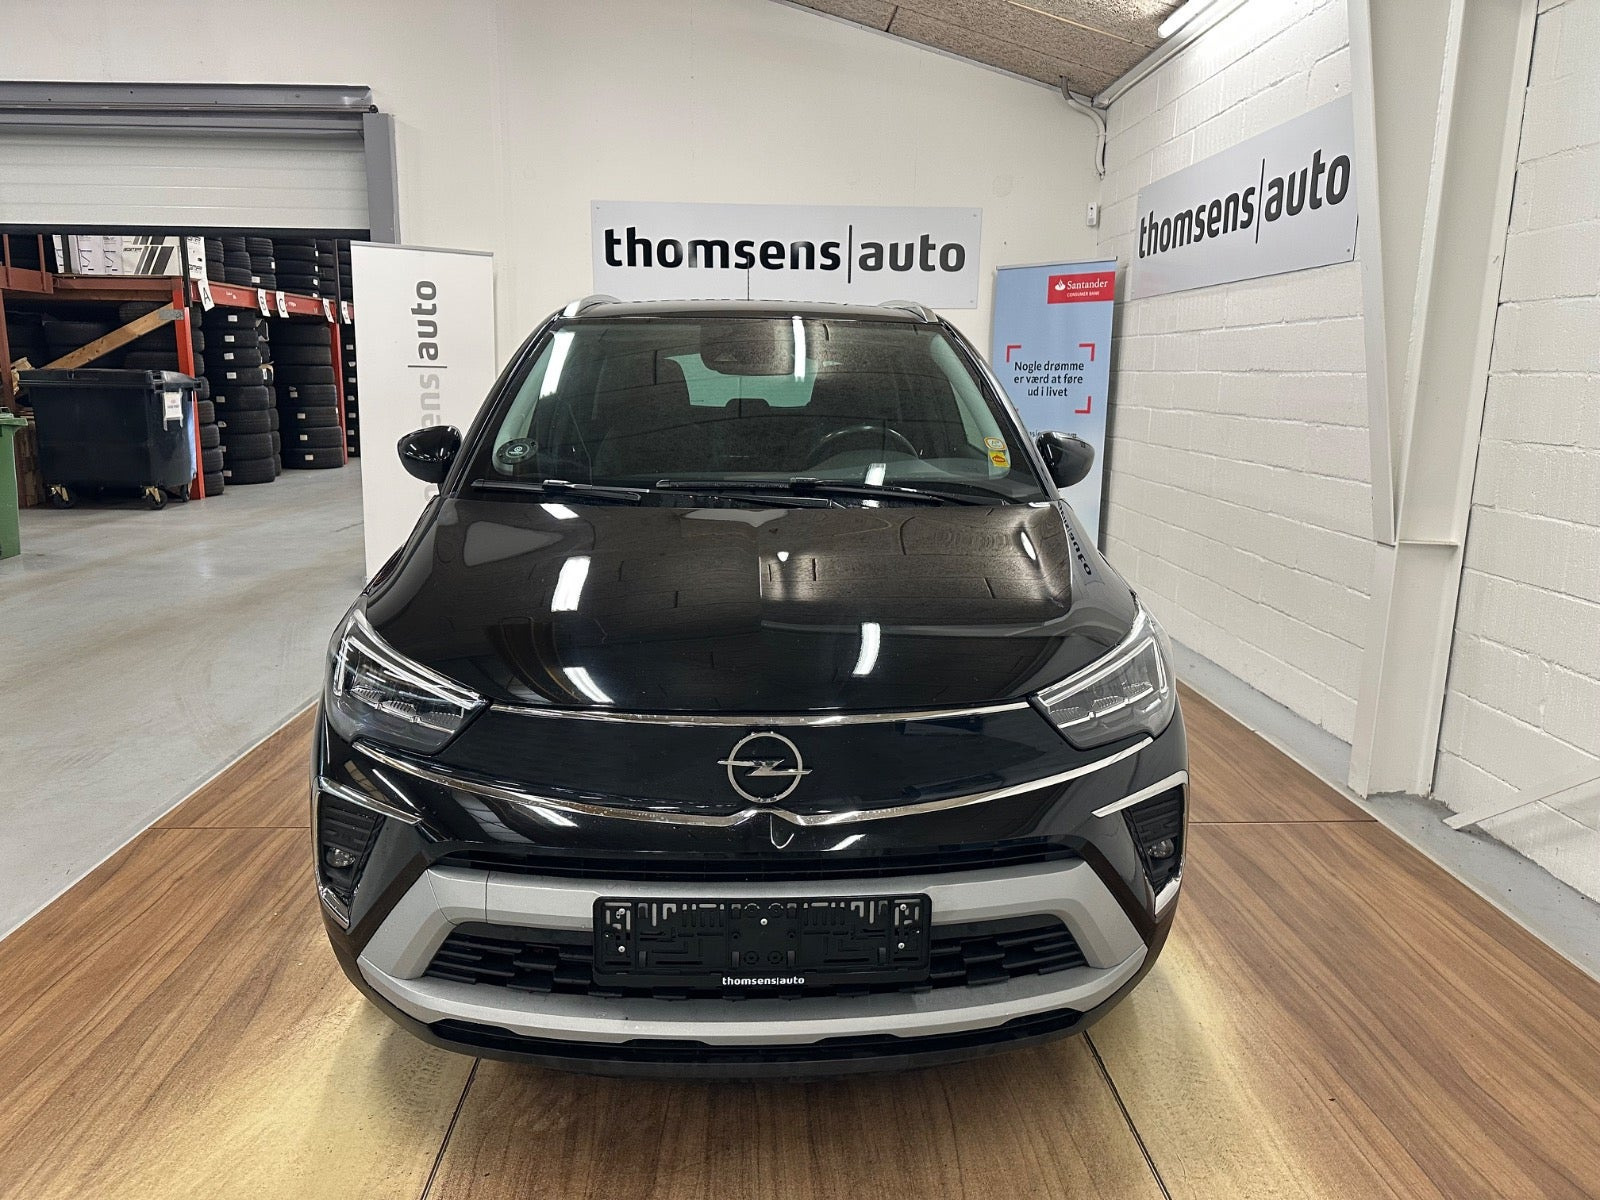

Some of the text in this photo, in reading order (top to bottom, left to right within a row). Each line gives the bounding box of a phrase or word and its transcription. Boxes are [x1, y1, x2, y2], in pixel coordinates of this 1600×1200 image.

[1067, 278, 1108, 290] Santander
[202, 287, 211, 304] A
[278, 298, 286, 313] C
[1014, 360, 1084, 373] Nogle drømme
[1013, 373, 1084, 384] er værd at føre
[1027, 386, 1039, 397] ud
[1046, 386, 1068, 397] livet
